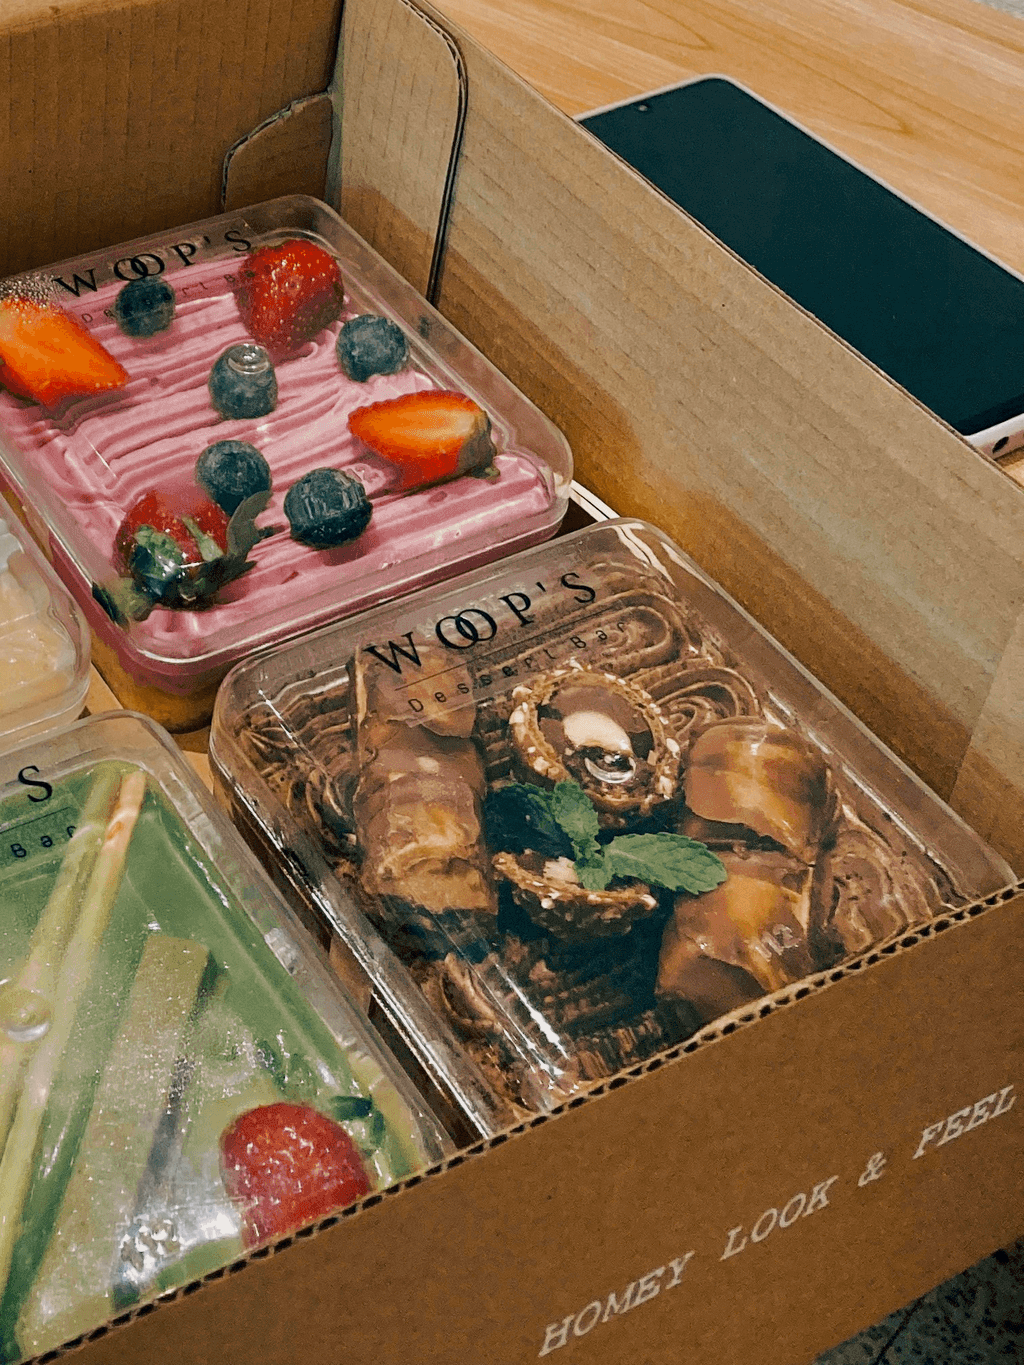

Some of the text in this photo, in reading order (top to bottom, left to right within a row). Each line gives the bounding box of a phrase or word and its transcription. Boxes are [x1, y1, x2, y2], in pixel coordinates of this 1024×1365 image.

[51, 230, 252, 298] WOOP'S
[363, 572, 596, 675] WOOP'S
[570, 621, 627, 650] Bar
[10, 825, 77, 858] Bar
[537, 1084, 1016, 1358] HOMEY LOOK & FEEL
